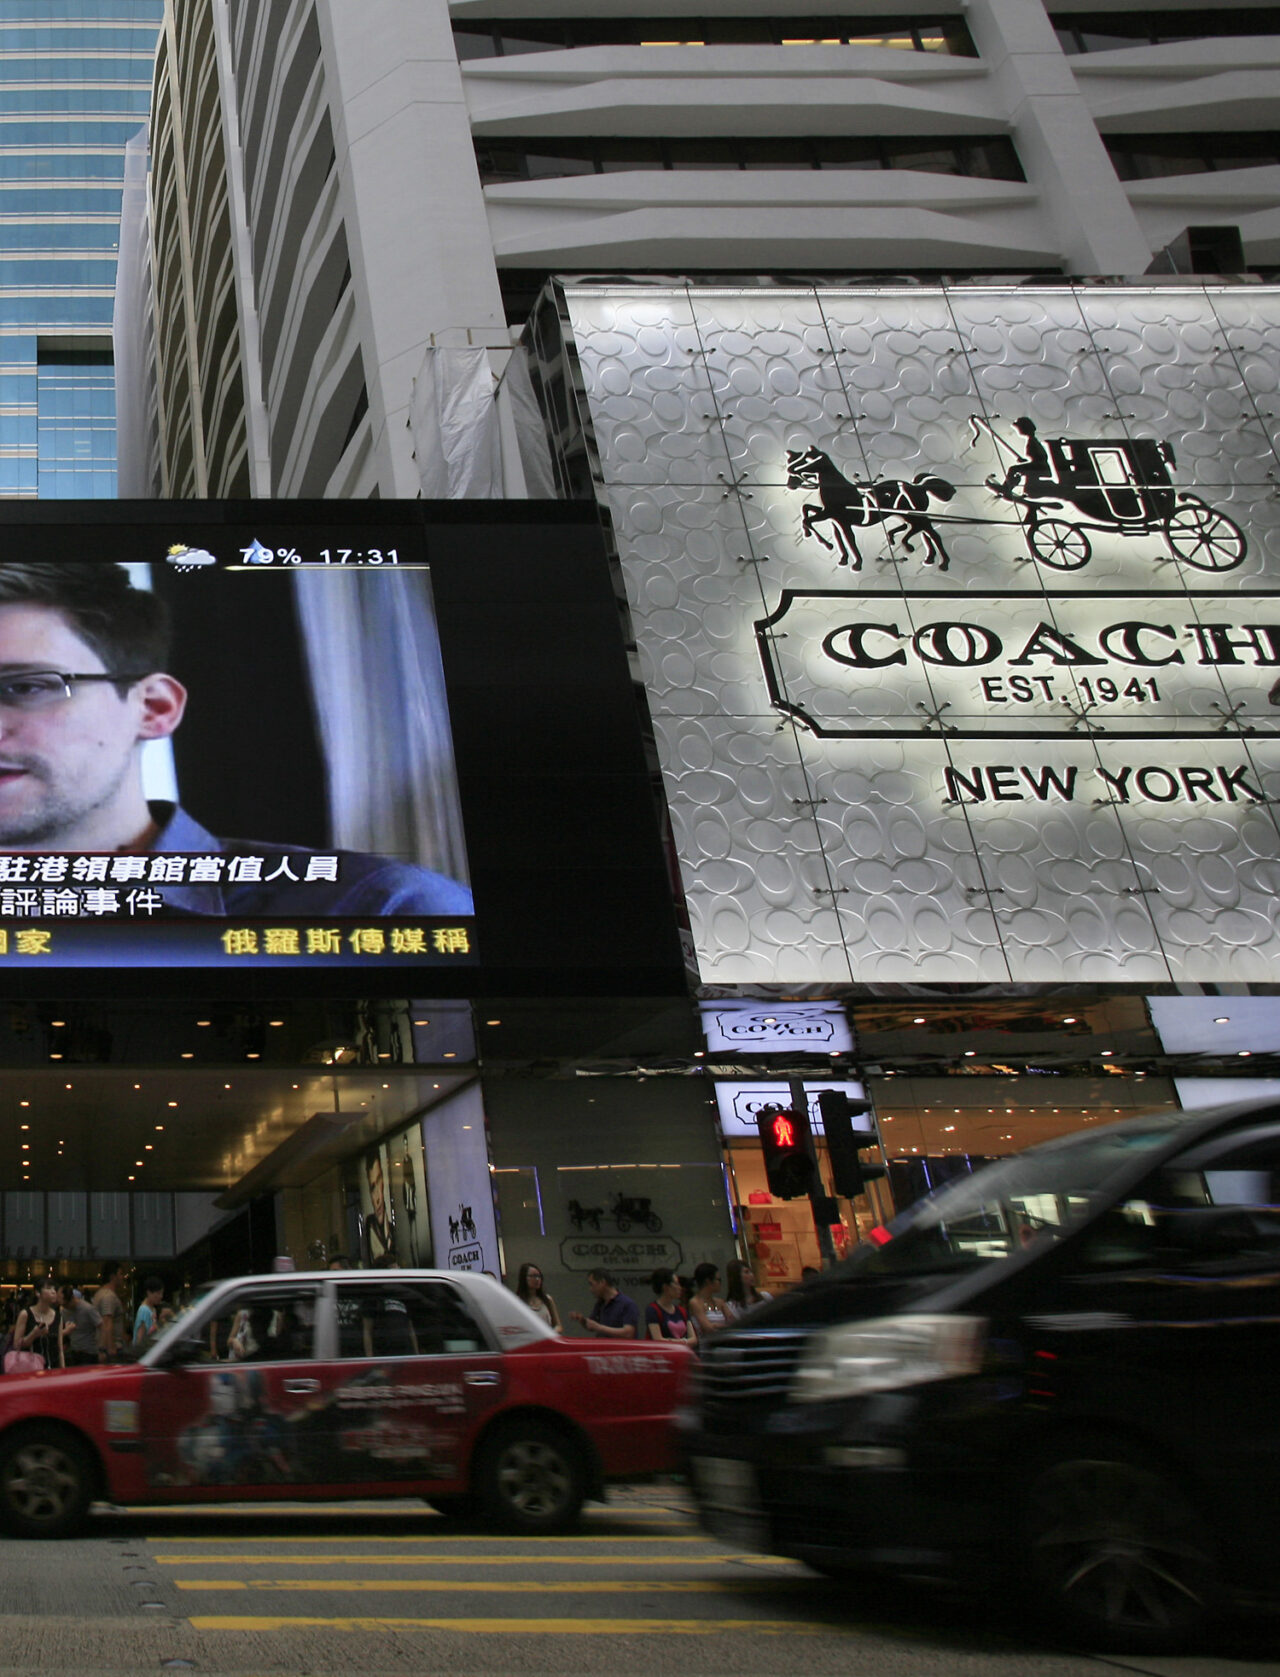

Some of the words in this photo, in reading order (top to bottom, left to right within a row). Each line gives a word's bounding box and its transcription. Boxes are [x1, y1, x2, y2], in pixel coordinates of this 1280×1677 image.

[239, 548, 302, 565] 79%
[319, 548, 400, 565] 17:31
[822, 621, 1280, 667] COACH
[980, 675, 1068, 704] EST.
[1079, 675, 1161, 704] 1941
[944, 766, 1078, 803] NEW
[1097, 766, 1265, 804] YORK
[221, 927, 471, 955] 俄羅斯傳媒稱
[452, 1250, 480, 1265] COACH
[572, 1243, 666, 1256] COACH
